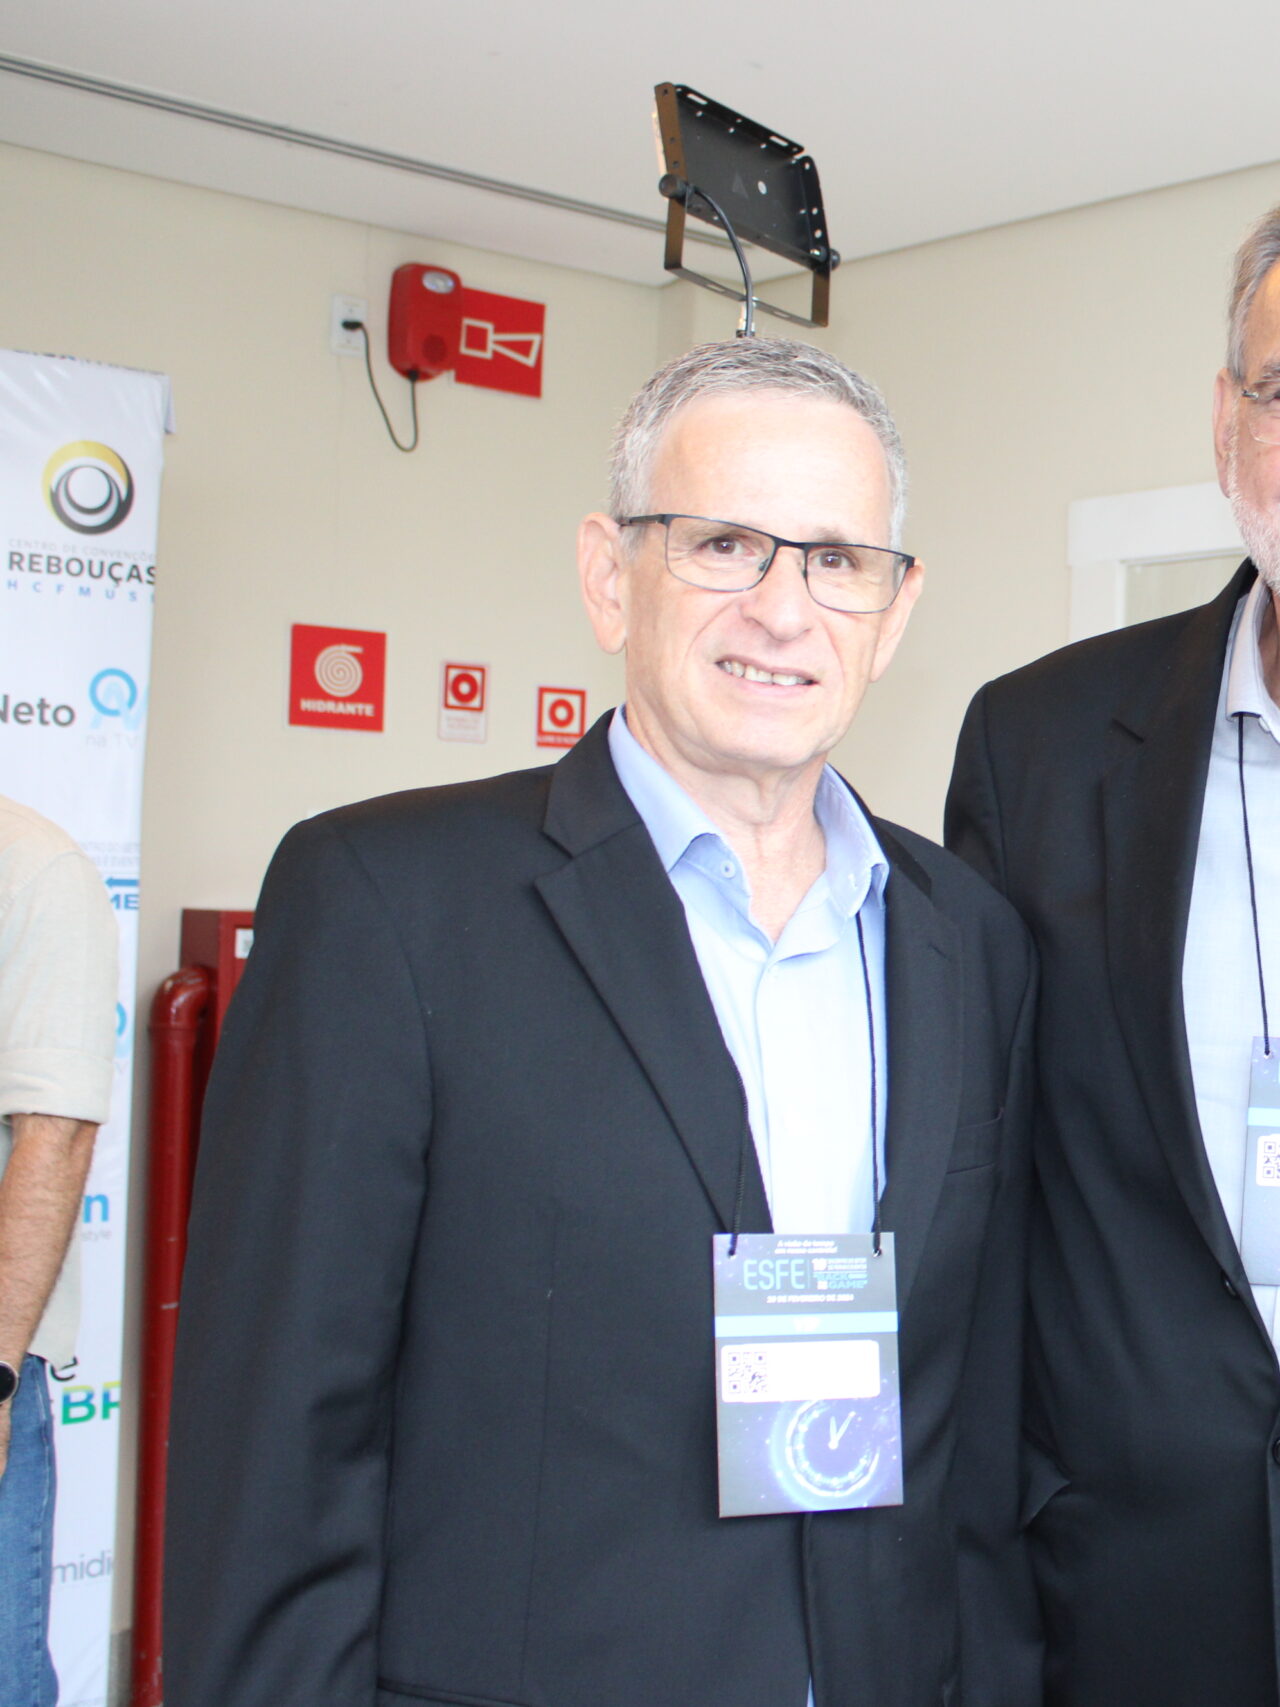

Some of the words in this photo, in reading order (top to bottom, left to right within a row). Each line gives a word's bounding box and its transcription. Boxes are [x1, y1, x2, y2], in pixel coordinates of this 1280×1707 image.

[8, 551, 157, 587] REBOUÇAS
[301, 700, 373, 716] HIDRANTE
[743, 1259, 805, 1290] ESFE
